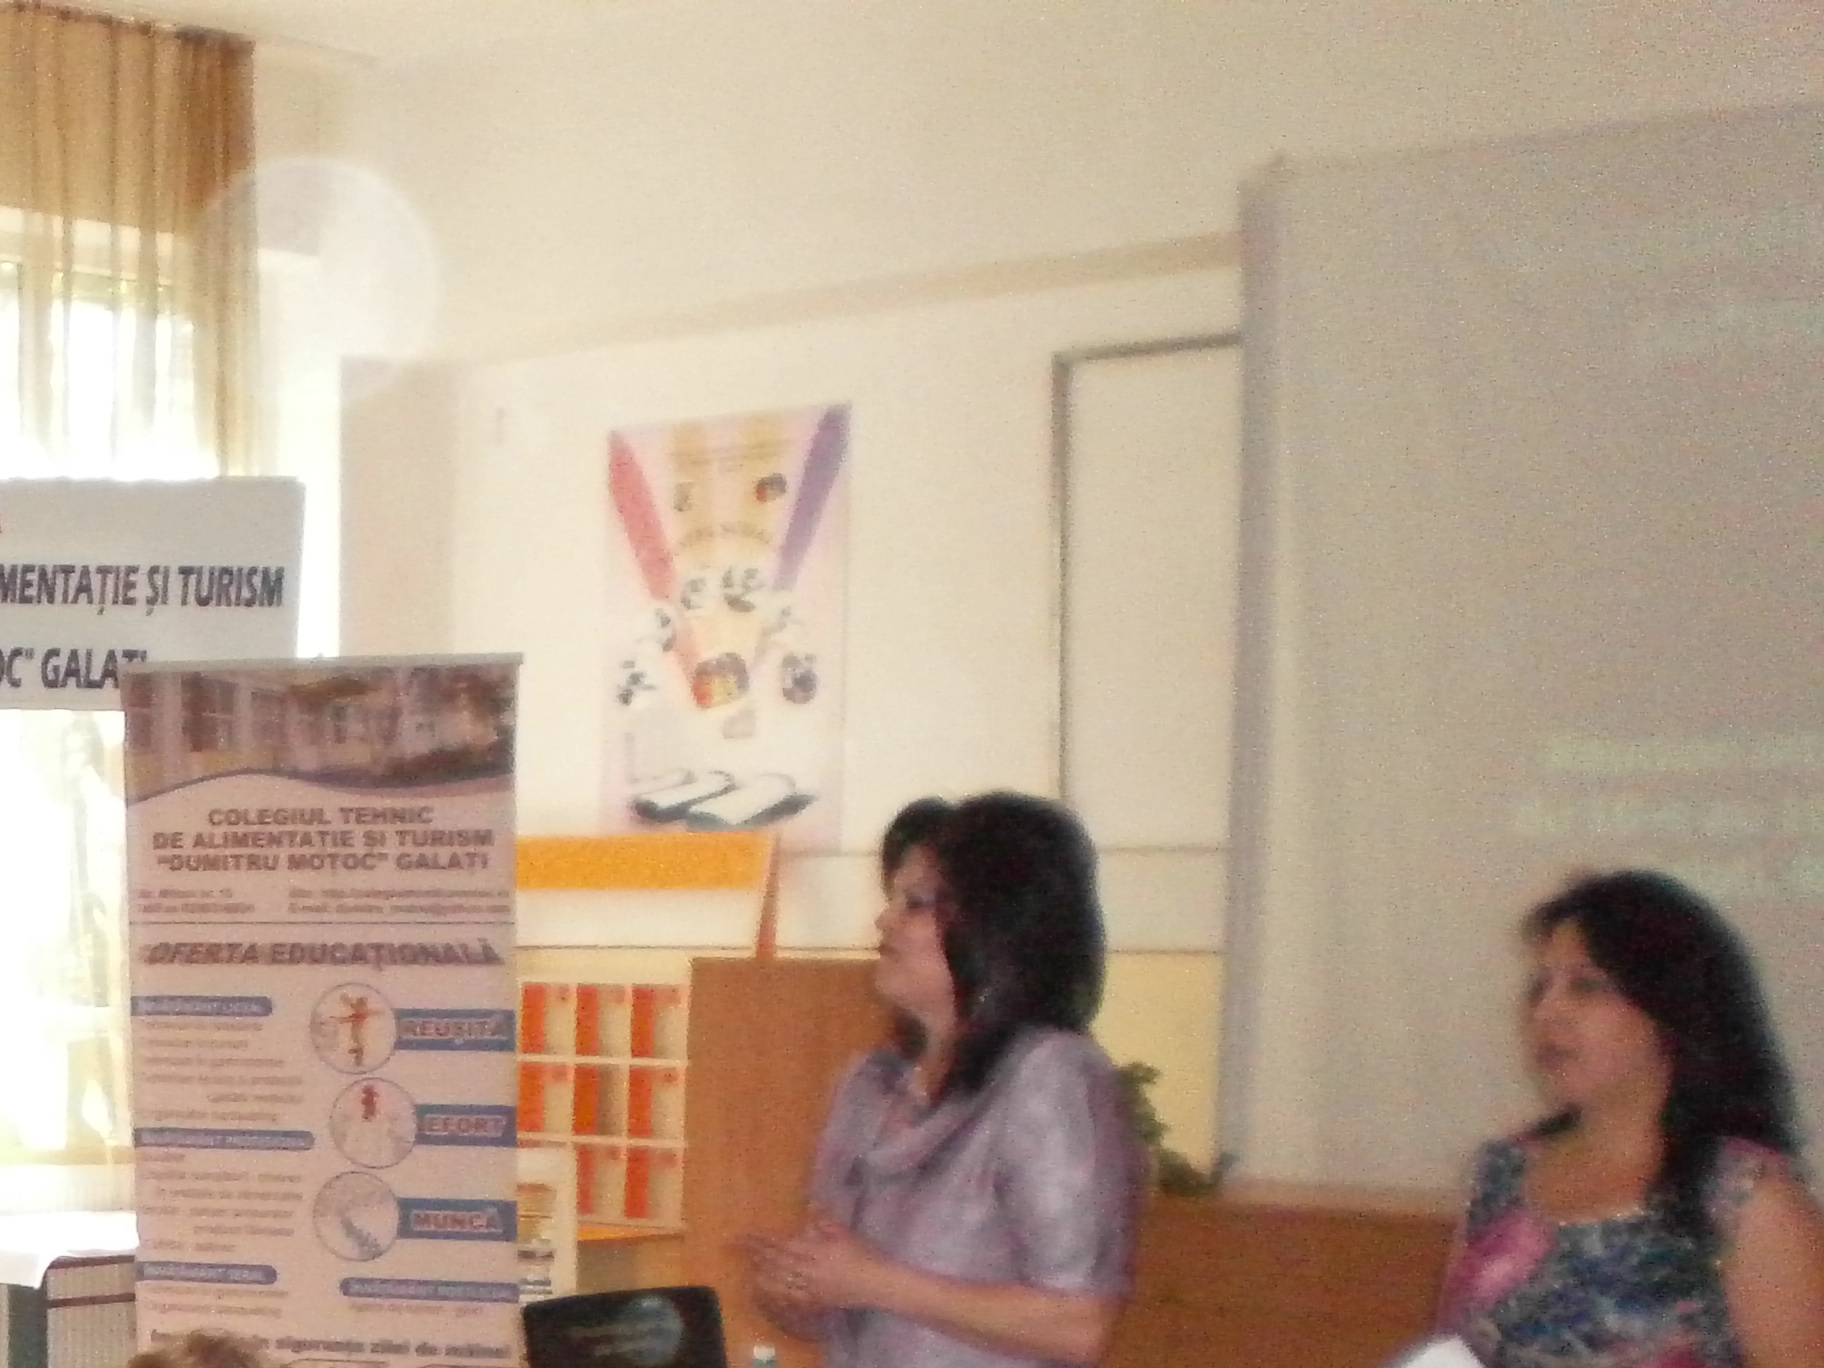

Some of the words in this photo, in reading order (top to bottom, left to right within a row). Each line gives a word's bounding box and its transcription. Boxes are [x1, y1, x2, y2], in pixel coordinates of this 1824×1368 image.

[178, 565, 285, 607] TURISM
[40, 648, 148, 689] GALA
[208, 808, 332, 826] COLEGIUL
[339, 806, 434, 825] TEHNIC
[153, 831, 183, 849] DE
[395, 829, 494, 847] TURISM
[146, 942, 260, 965] OFERTA
